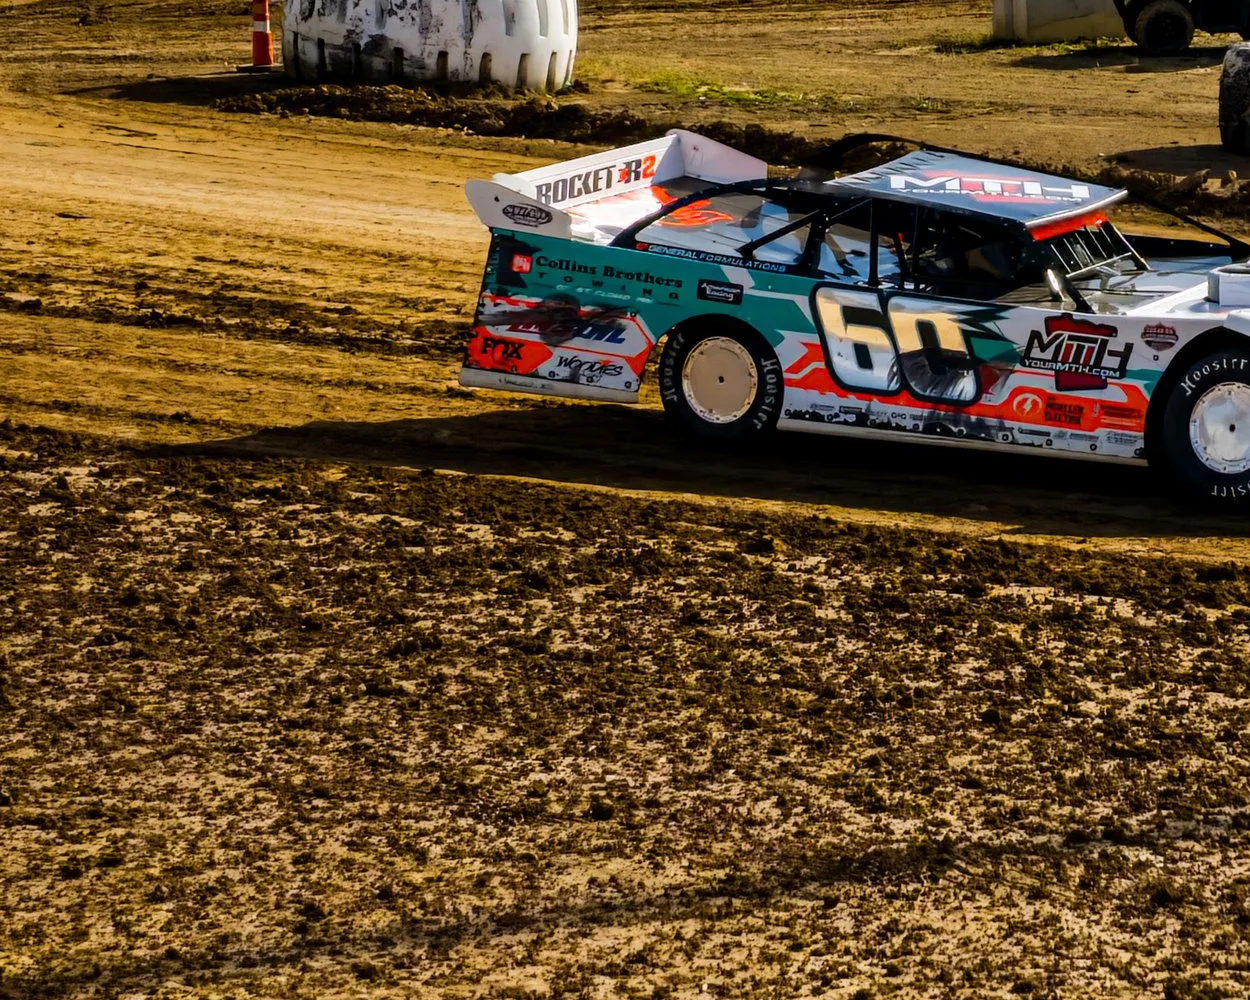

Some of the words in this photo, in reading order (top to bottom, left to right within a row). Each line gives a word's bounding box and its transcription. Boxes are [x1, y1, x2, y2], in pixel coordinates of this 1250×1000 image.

[536, 164, 616, 205] ROCKET
[889, 174, 1090, 198] MTH
[536, 255, 597, 276] Collins
[603, 264, 683, 288] Brothers
[648, 244, 698, 259] GENERAL
[699, 253, 787, 272] FORMULATIONS
[481, 337, 525, 360] FOX
[809, 281, 982, 408] 60
[1022, 330, 1134, 376] MTH
[1024, 358, 1120, 379] YOURMTH.COM
